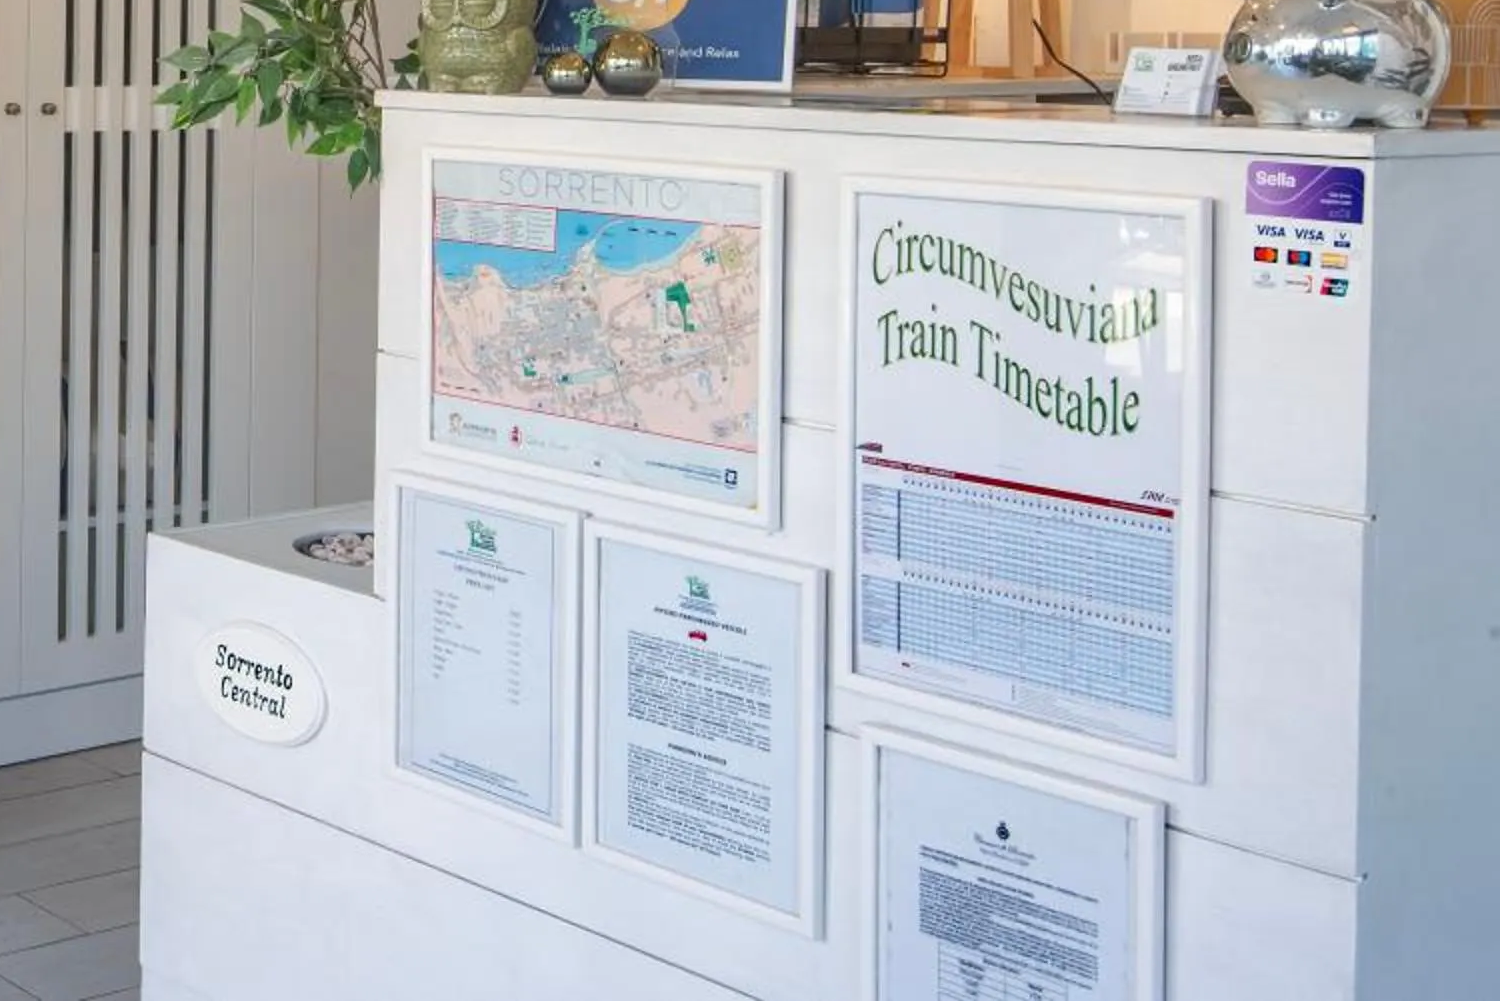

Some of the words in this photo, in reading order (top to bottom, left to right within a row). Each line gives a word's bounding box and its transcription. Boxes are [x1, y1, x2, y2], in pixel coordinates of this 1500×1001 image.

[499, 167, 683, 211] SORRENTO
[1255, 170, 1296, 188] Sella
[1257, 224, 1286, 237] VISA
[1294, 228, 1325, 241] VISA
[872, 220, 1159, 345] Circumvesuviana
[877, 303, 959, 367] Train
[970, 318, 1140, 436] Timetable
[215, 644, 293, 690] Sorrento
[221, 676, 286, 719] Central
